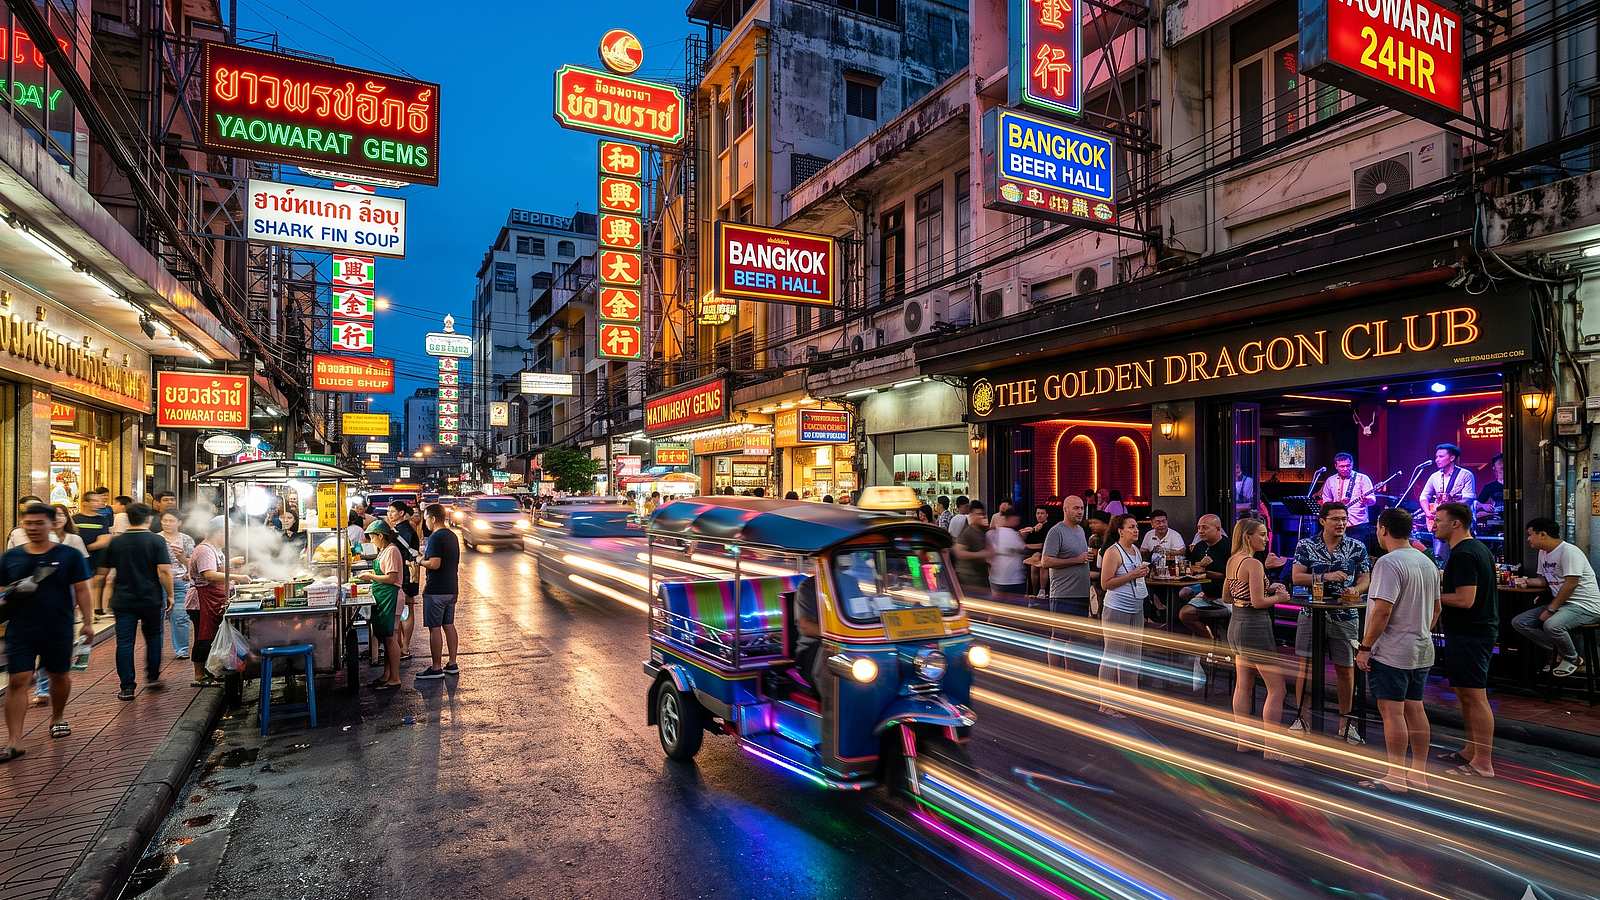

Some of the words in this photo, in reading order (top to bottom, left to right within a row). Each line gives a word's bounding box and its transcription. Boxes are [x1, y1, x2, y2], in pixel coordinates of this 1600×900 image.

[1360, 26, 1436, 94] 24HR
[216, 114, 353, 155] YAOWARAT
[363, 138, 428, 168] GEMS
[1008, 122, 1106, 170] BANGKOK
[1010, 153, 1057, 180] BEER
[1062, 166, 1105, 192] HALL
[254, 219, 314, 240] SHARK
[321, 227, 347, 243] FIN
[355, 231, 400, 248] SOUP
[729, 240, 826, 276] BANGKOK
[734, 270, 776, 289] BEER
[782, 276, 821, 294] HALL
[341, 261, 366, 347] 興金行
[995, 379, 1038, 408] THE
[1043, 359, 1155, 401] GOLDEN
[1163, 330, 1327, 385] DRAGON
[1341, 307, 1480, 360] CLUB
[164, 408, 215, 421] YAOWARAT
[216, 410, 242, 423] GEMS
